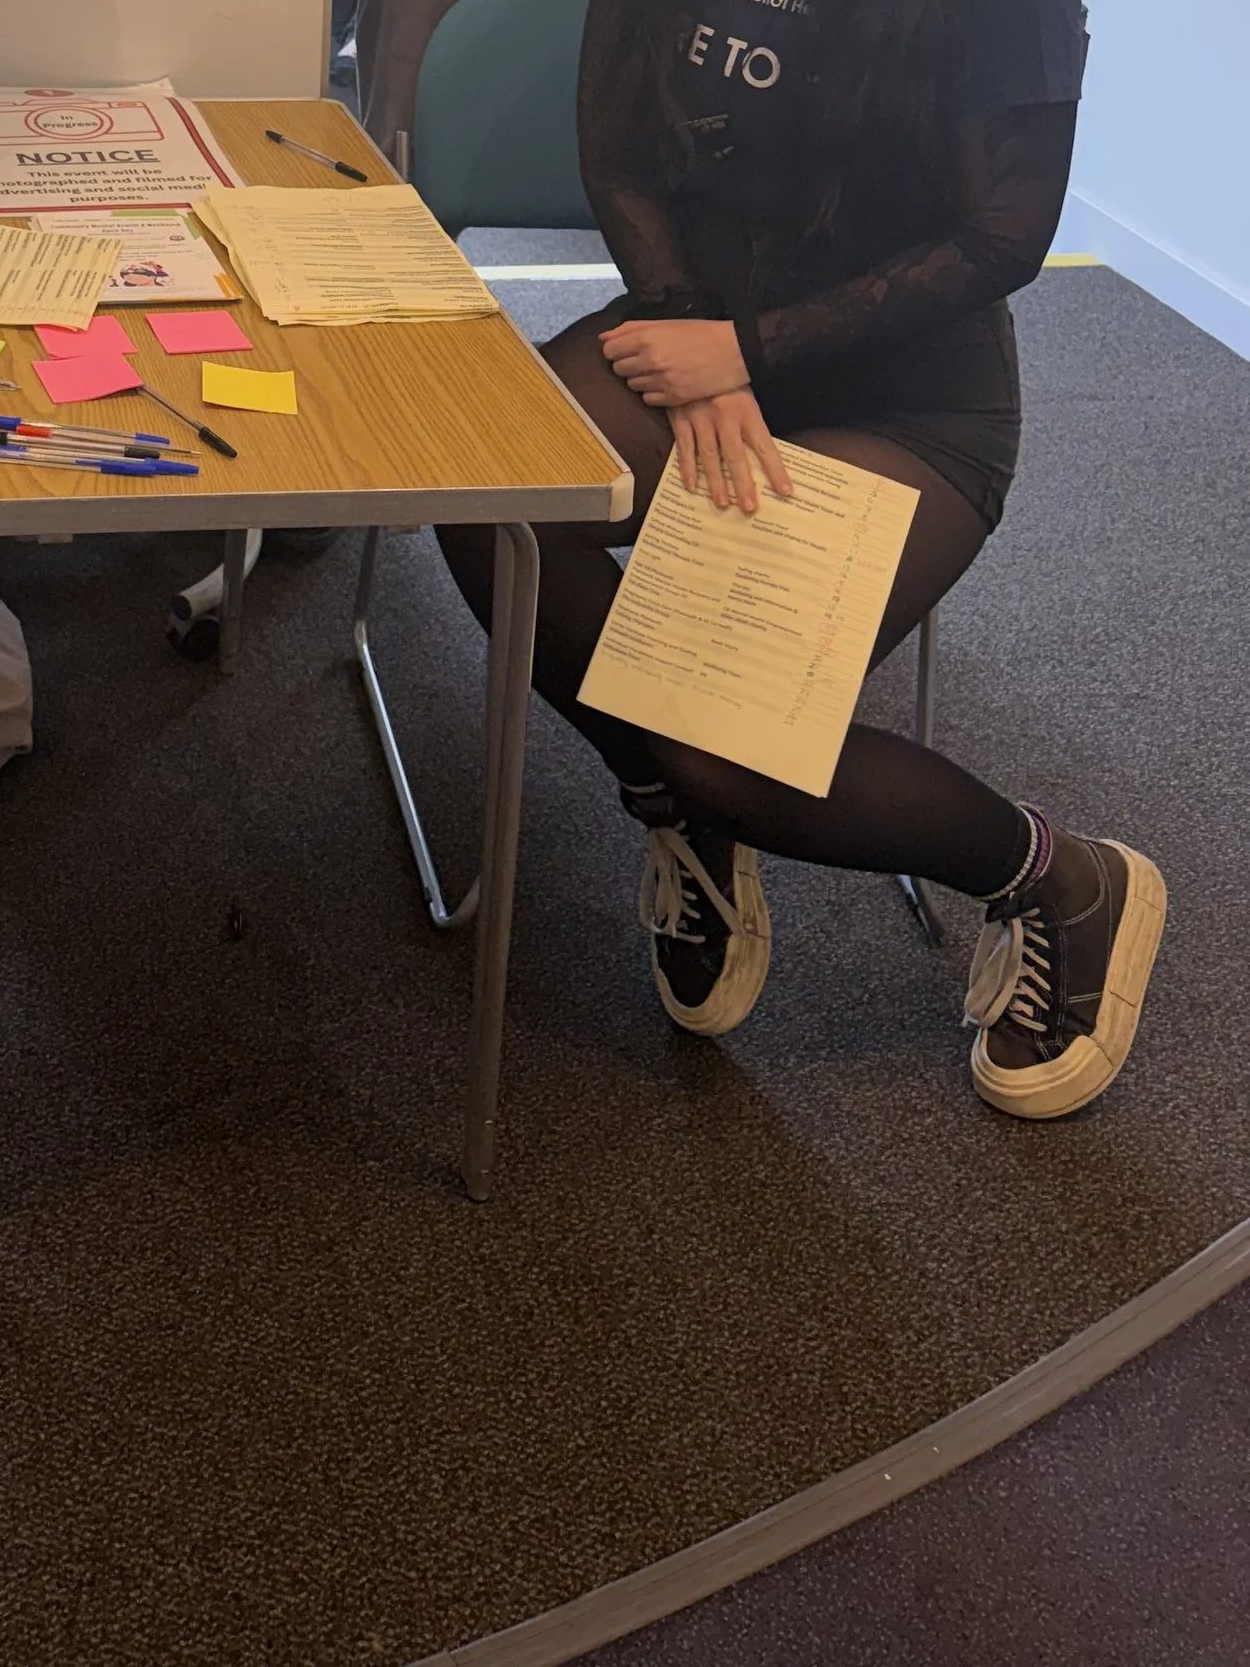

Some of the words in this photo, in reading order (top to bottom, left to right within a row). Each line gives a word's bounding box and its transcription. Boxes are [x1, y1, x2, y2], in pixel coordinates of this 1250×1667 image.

[723, 36, 782, 89] TO
[42, 120, 99, 129] Progress
[15, 148, 161, 165] NOTICE
[26, 170, 60, 178] This
[63, 169, 107, 177] event
[111, 168, 139, 176] will
[142, 167, 163, 175] be
[102, 175, 133, 184] and
[135, 174, 186, 184] filmed
[188, 173, 213, 182] for
[87, 185, 115, 194] and
[118, 183, 164, 193] social
[168, 182, 207, 191] medi
[69, 194, 150, 204] purposes.
